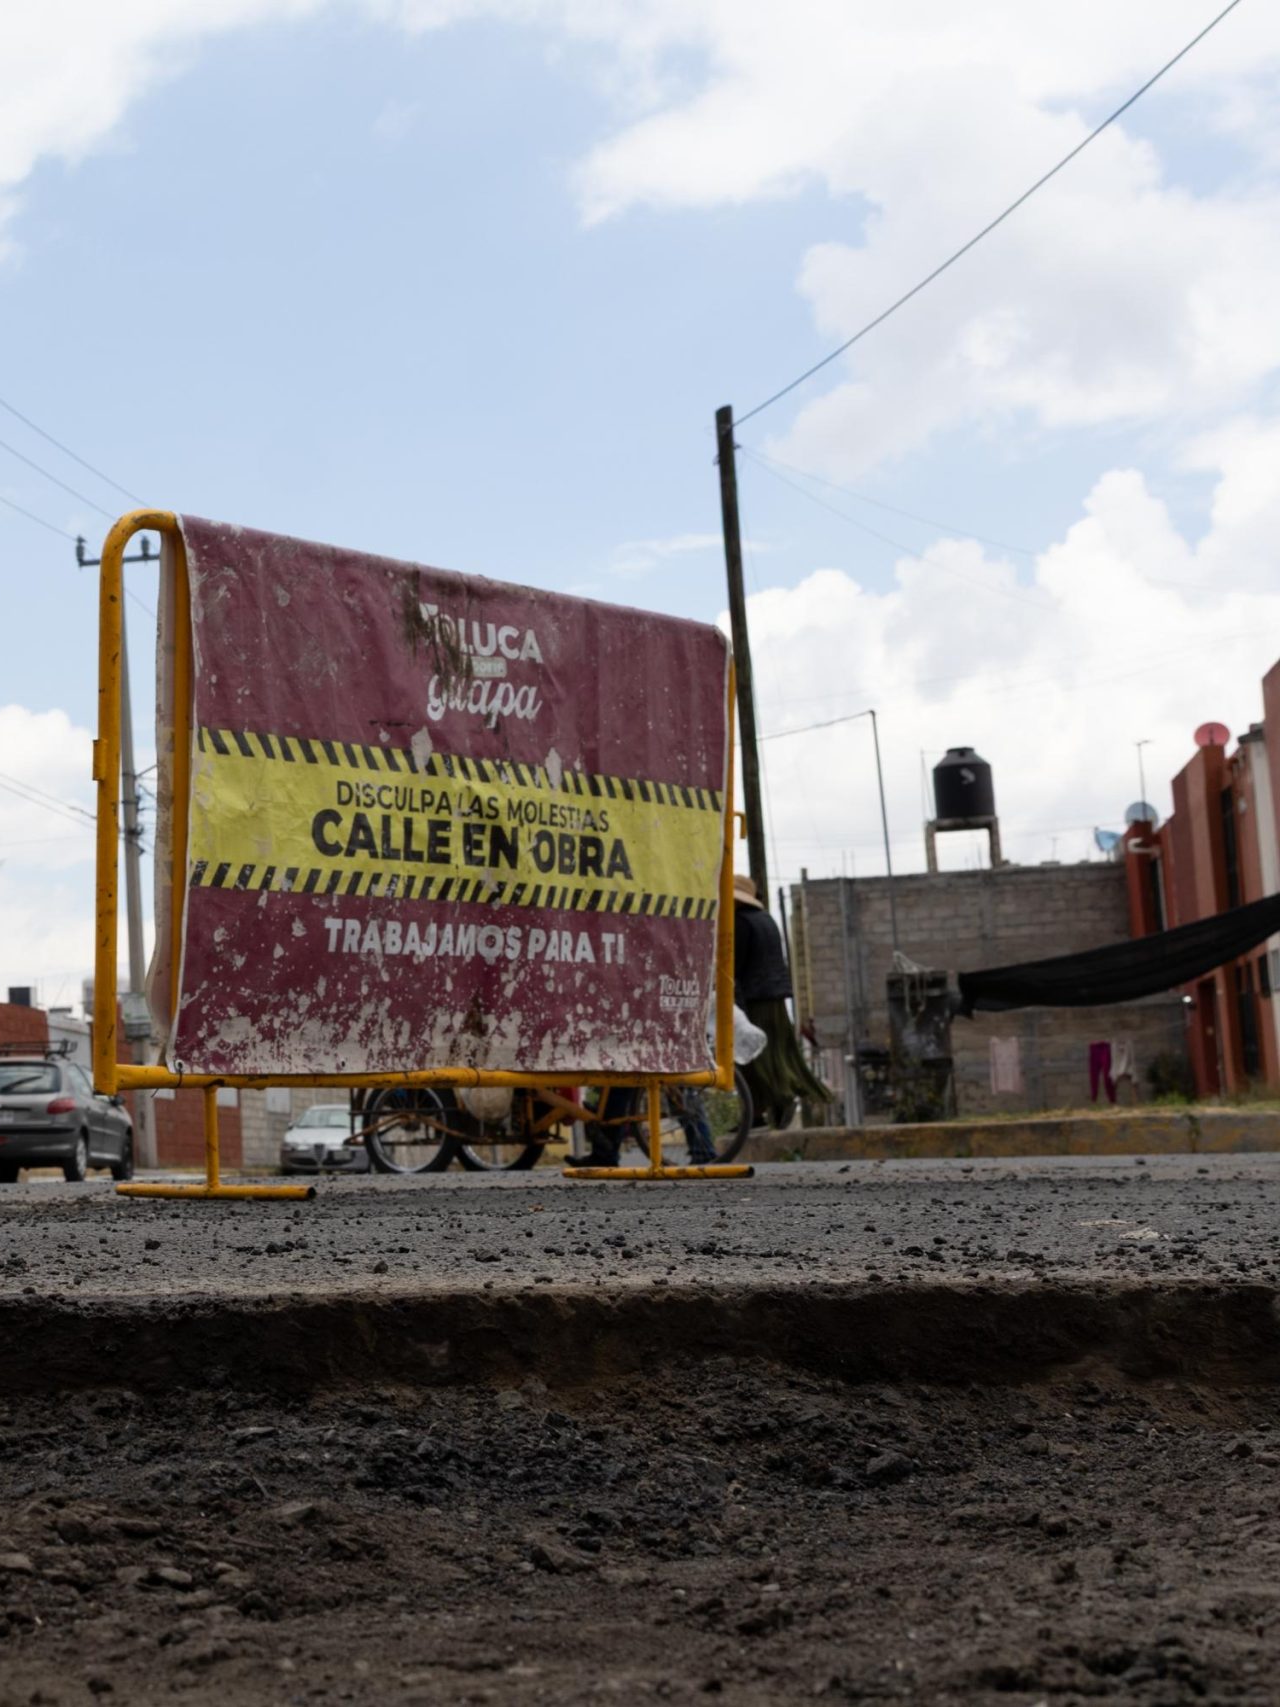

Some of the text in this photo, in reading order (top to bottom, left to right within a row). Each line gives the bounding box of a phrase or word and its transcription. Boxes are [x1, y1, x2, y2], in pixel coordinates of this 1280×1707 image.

[336, 780, 609, 832] DISCULPA LAS MOLESTIAS
[311, 808, 634, 880] CALLE EN OBRA
[324, 917, 625, 964] TRABAJAMOS PARA TI
